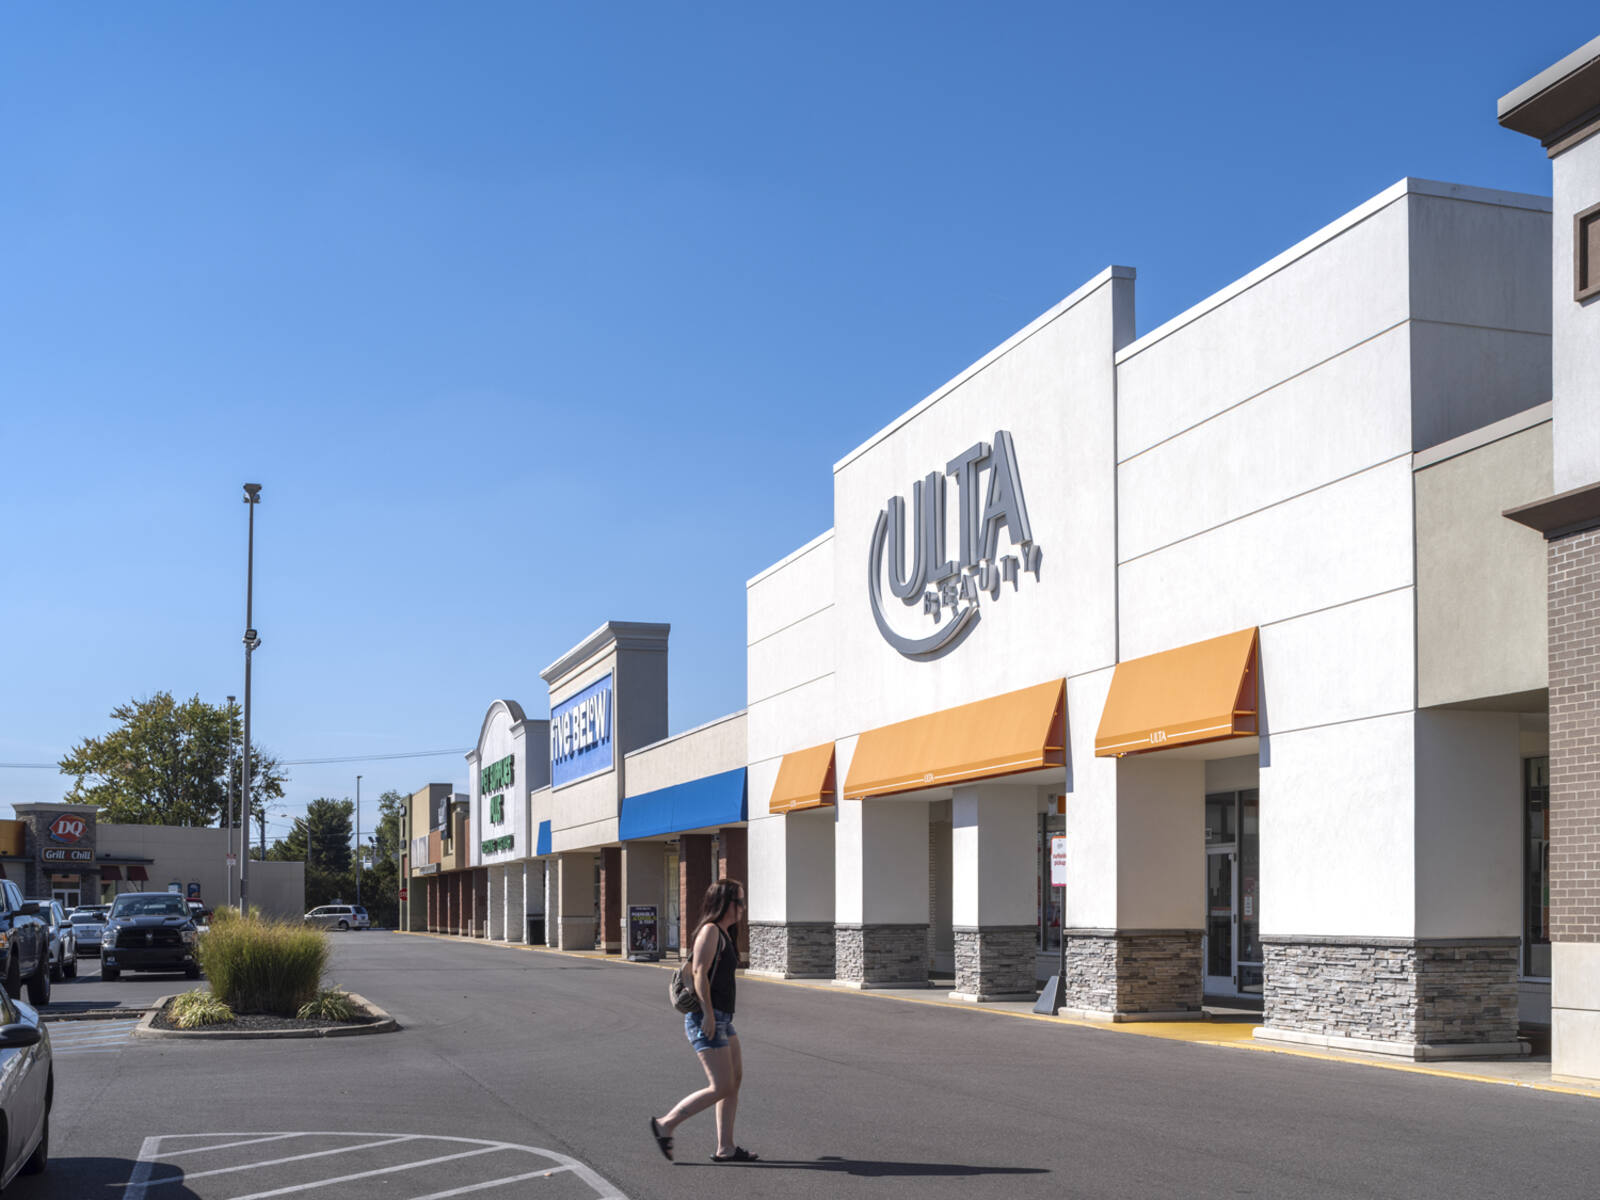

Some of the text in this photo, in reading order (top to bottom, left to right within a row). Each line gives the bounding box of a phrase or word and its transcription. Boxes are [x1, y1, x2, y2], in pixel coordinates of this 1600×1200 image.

[888, 430, 1032, 598] ULTA
[923, 544, 1042, 616] BEAUTY
[1150, 730, 1167, 744] ULTA
[56, 820, 83, 837] DQ
[46, 850, 65, 860] Grill
[71, 850, 91, 860] Chill
